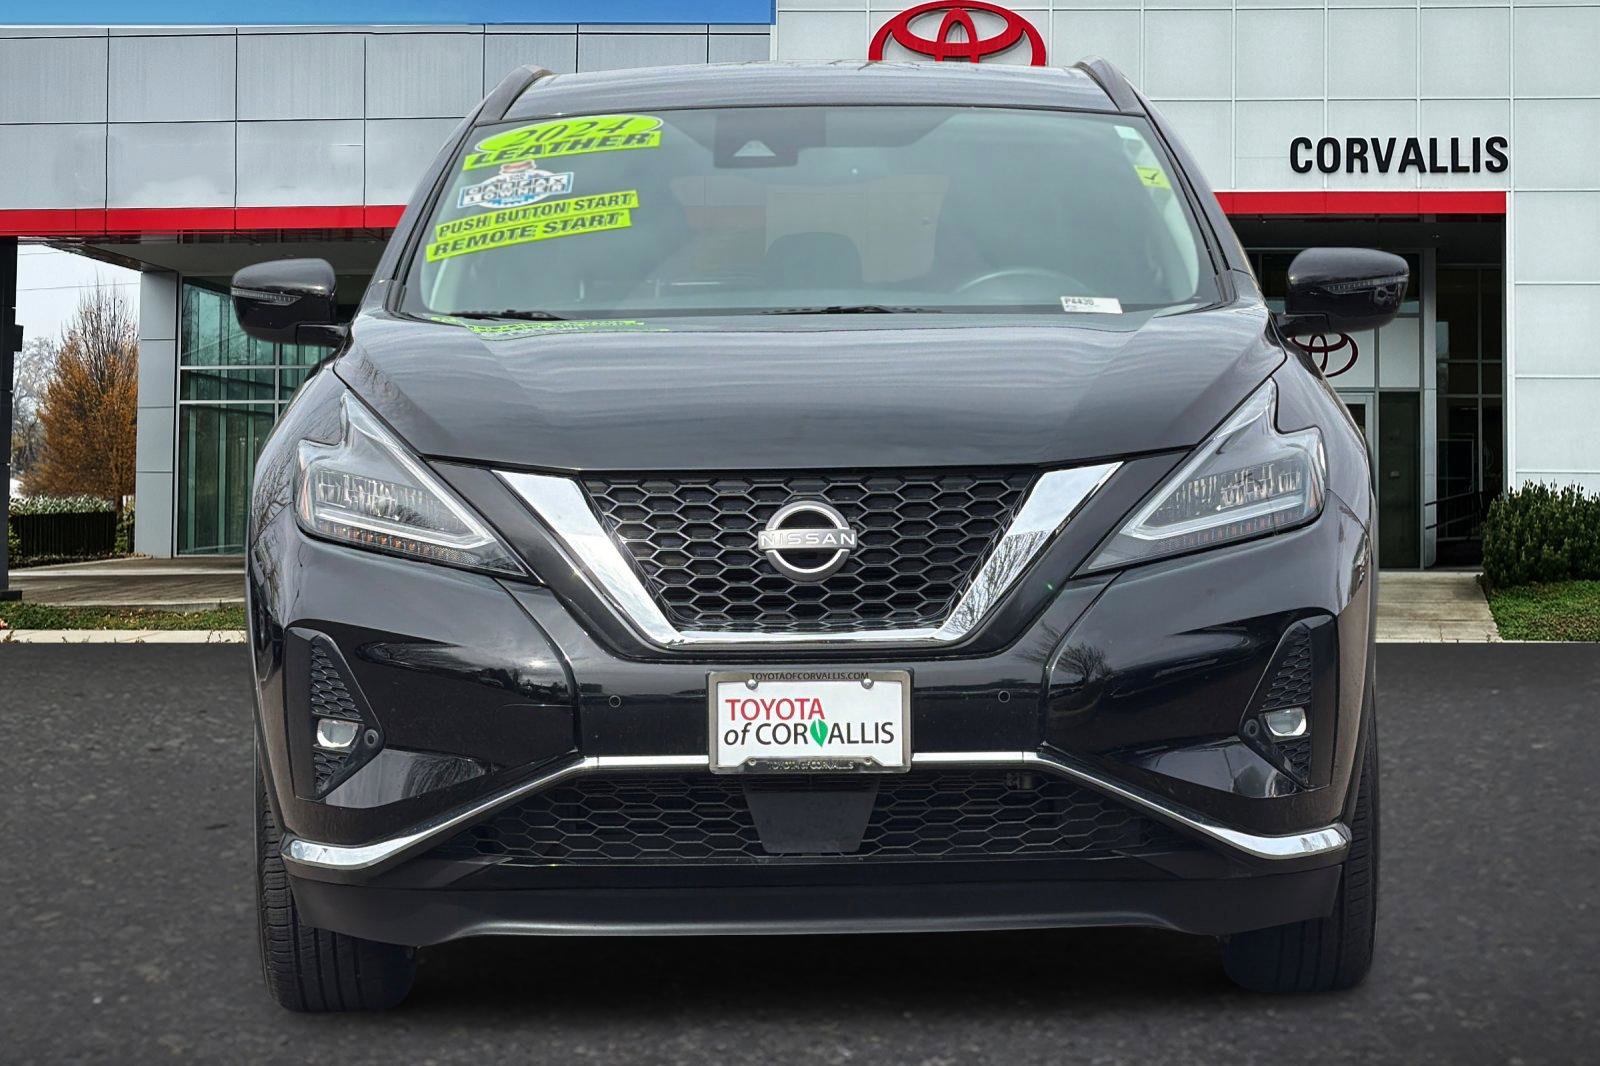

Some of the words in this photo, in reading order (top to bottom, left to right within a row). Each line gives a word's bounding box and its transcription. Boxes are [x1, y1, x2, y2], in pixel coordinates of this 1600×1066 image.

[504, 117, 635, 147] 2024
[472, 133, 652, 166] LEATHER
[1290, 137, 1508, 174] CORVALLIS
[438, 216, 488, 238] PUSH
[495, 201, 568, 223] BUTTON
[573, 193, 631, 211] START
[432, 225, 537, 257] REMOTE
[543, 212, 620, 235] START
[761, 533, 856, 547] NISSAN
[750, 672, 869, 680] TOYOTAOFCORVALLIS.COM
[725, 698, 825, 721] TOYOTA
[724, 722, 752, 746] of
